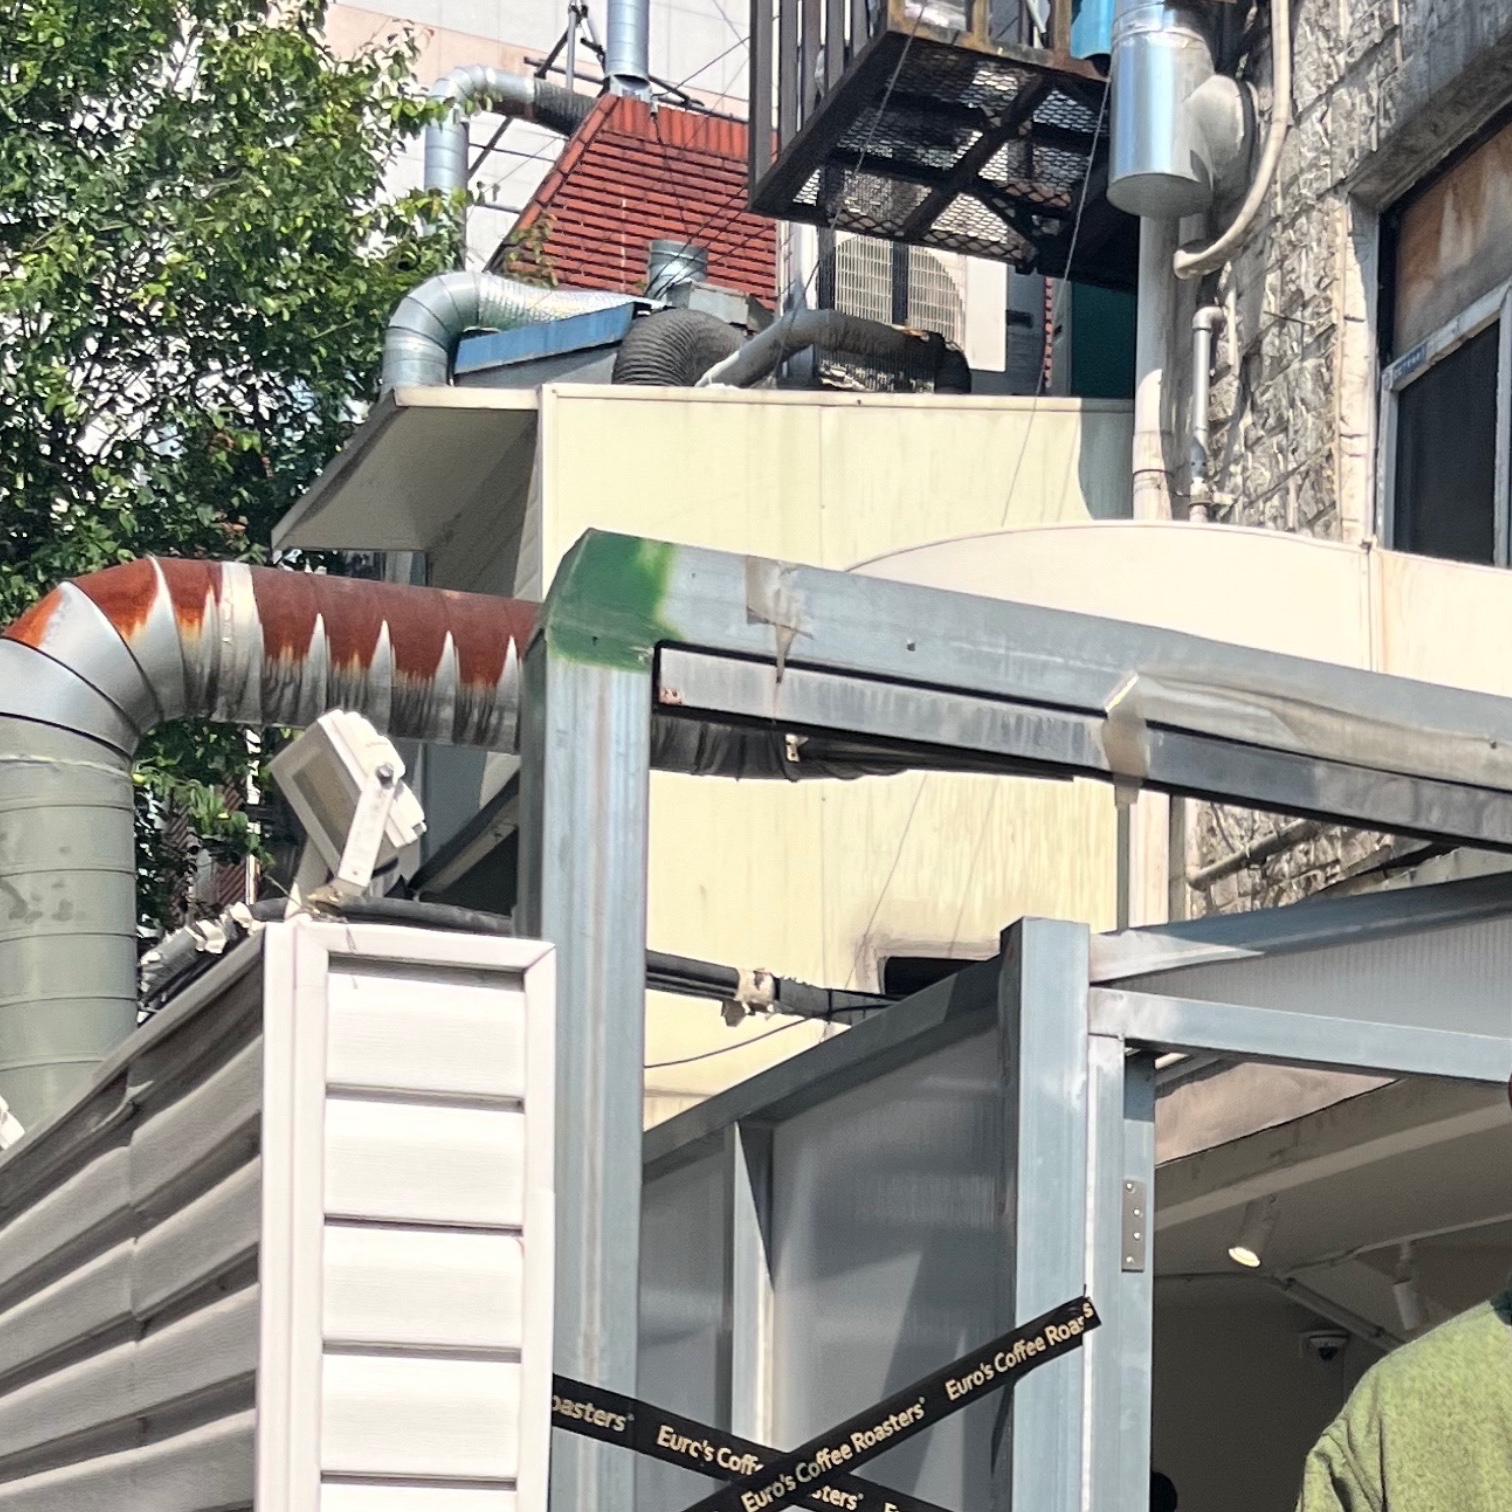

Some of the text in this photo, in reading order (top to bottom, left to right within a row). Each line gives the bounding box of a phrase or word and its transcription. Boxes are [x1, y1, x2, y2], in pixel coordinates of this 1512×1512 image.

[944, 1363, 995, 1401] Euro's
[994, 1339, 1047, 1373] Coffee
[551, 1395, 627, 1433] oasters
[716, 1447, 765, 1475] Coff
[795, 1447, 853, 1483] Coffee
[850, 1402, 925, 1453] Roasters
